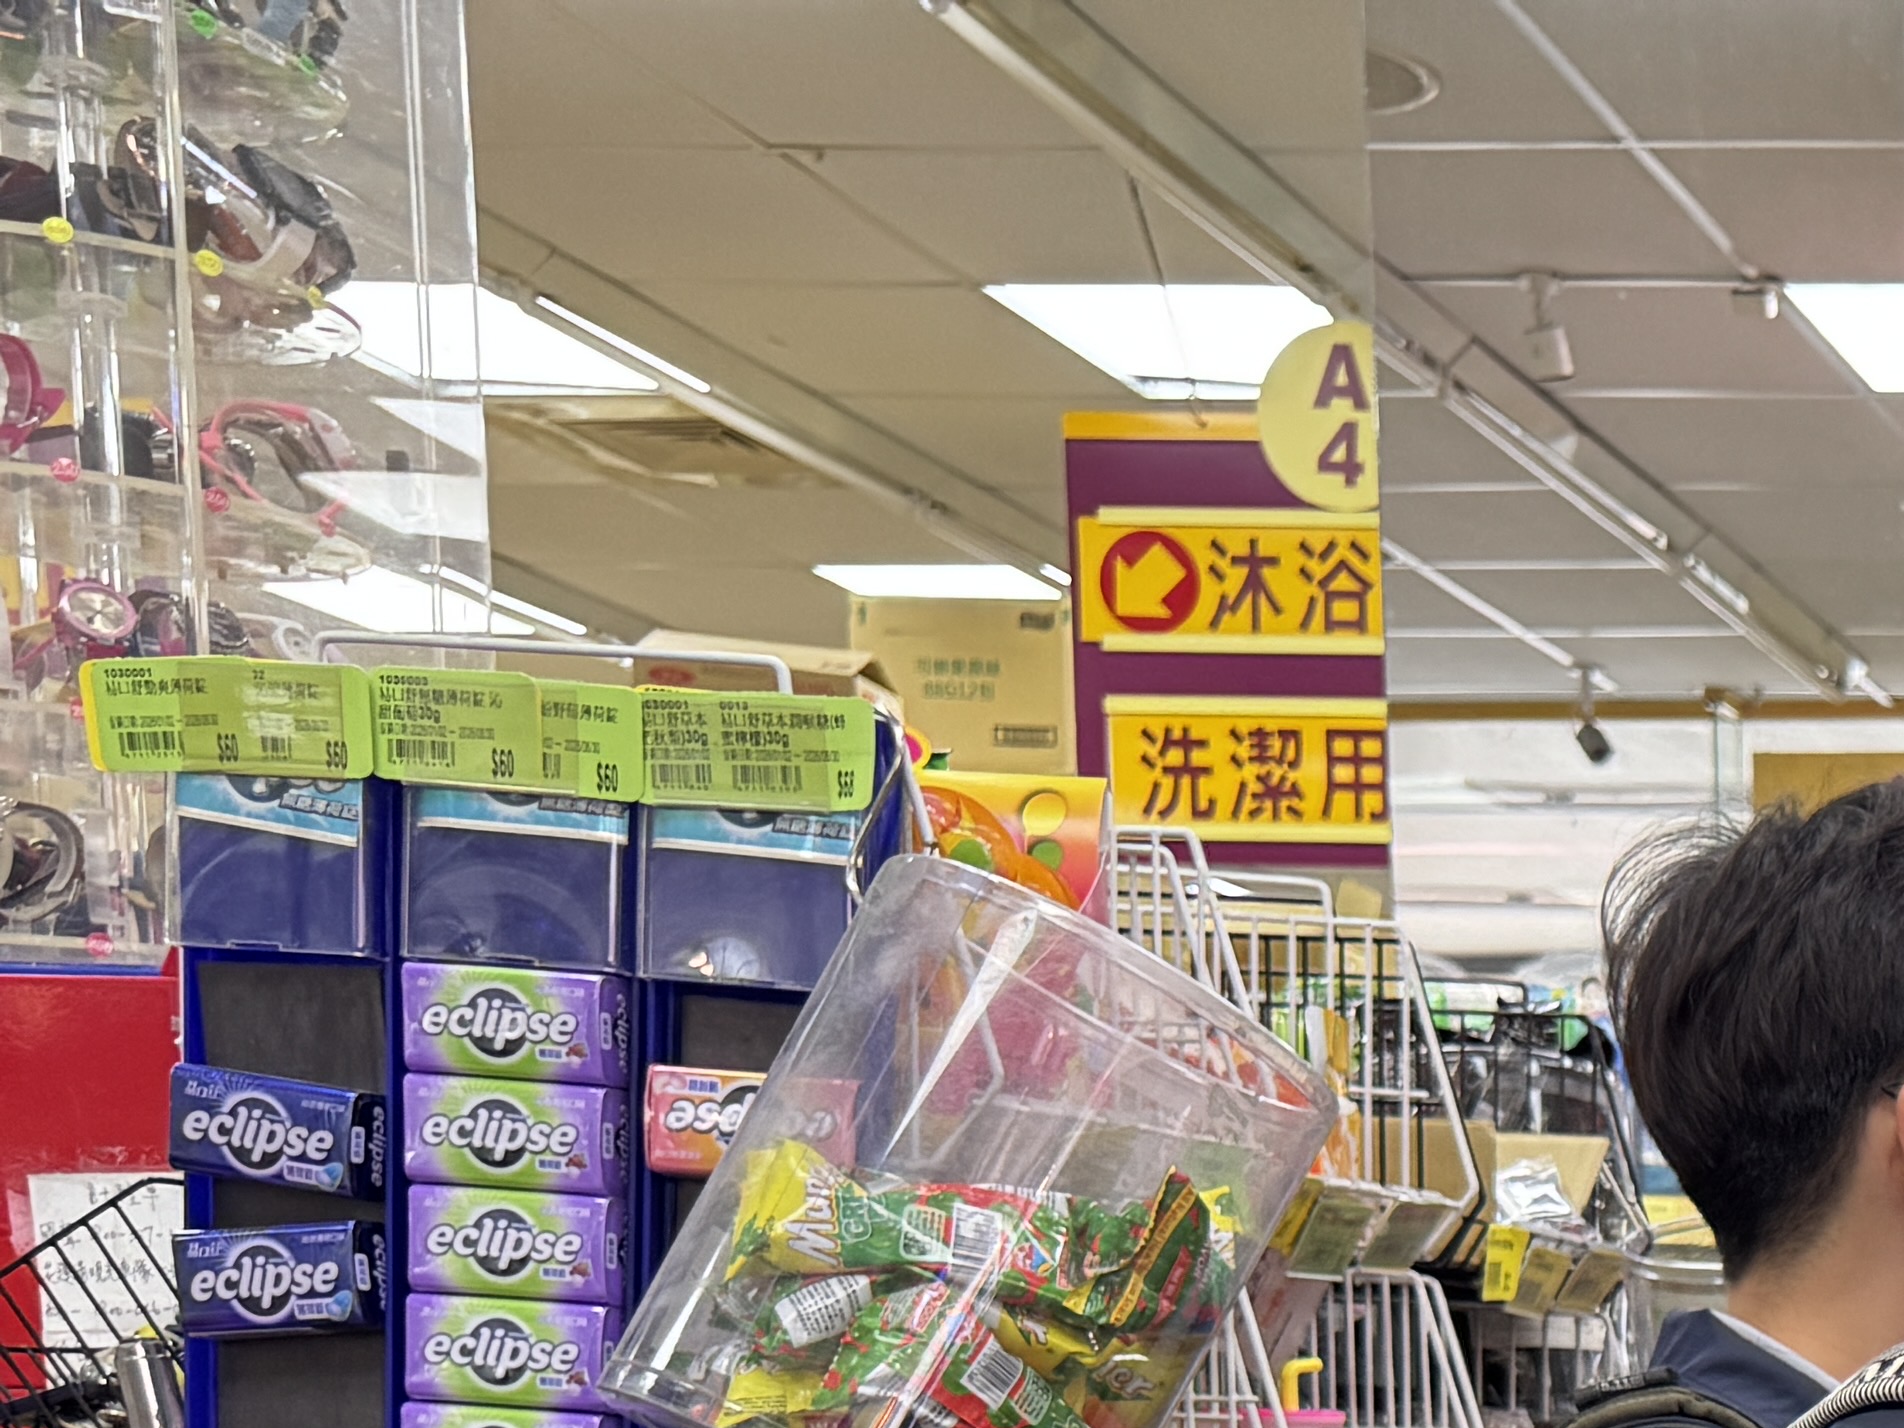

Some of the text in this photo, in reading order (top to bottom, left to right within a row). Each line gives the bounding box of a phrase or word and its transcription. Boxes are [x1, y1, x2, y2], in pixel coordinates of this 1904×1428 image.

[1313, 344, 1370, 409] A
[1317, 421, 1365, 488] 4
[1209, 536, 1374, 635] 沐浴
[491, 748, 514, 778] $60
[596, 762, 618, 794] $60
[1140, 726, 1389, 822] 洗潔用
[421, 997, 579, 1051] eclipse
[183, 1106, 334, 1163] eclipse
[422, 1107, 579, 1162] eclipse
[426, 1217, 583, 1270] eclipse
[190, 1252, 340, 1310] eclipse
[424, 1328, 580, 1380] eclipse
